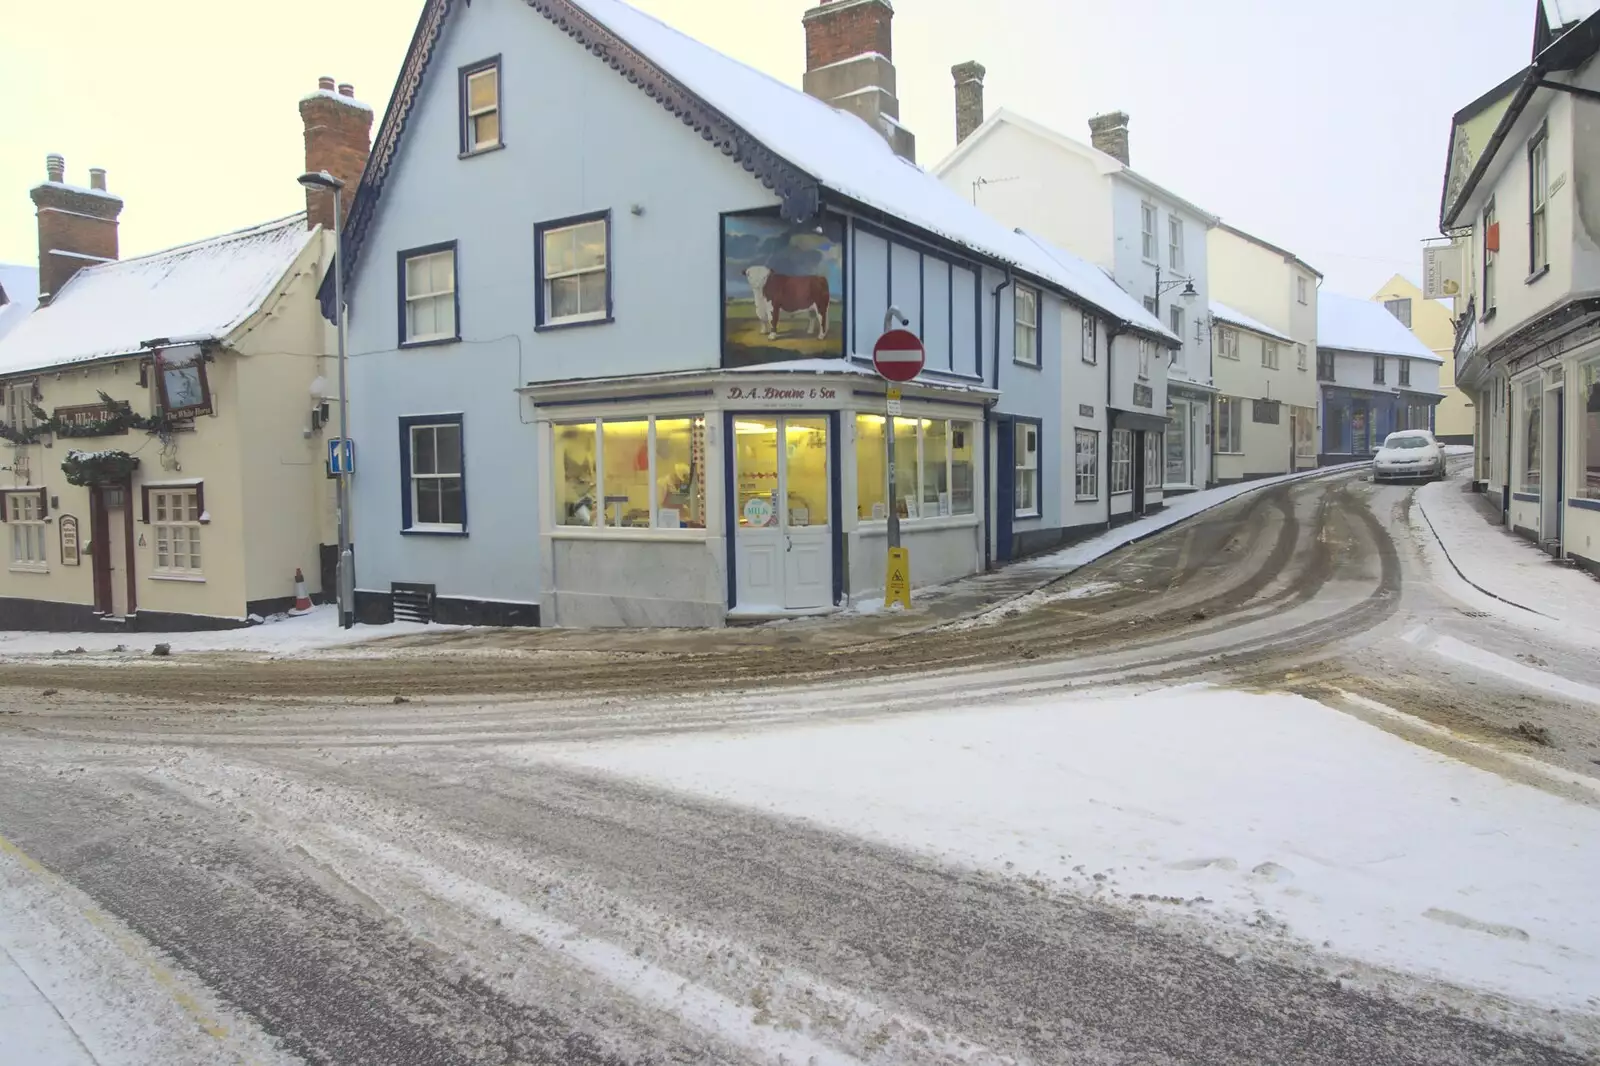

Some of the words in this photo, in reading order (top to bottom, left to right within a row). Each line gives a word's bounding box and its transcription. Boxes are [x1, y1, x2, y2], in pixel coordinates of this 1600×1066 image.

[762, 387, 805, 400] Browne
[809, 388, 817, 399] &
[819, 387, 836, 399] Son
[166, 412, 177, 421] The
[178, 409, 194, 418] White
[748, 507, 768, 515] MILK
